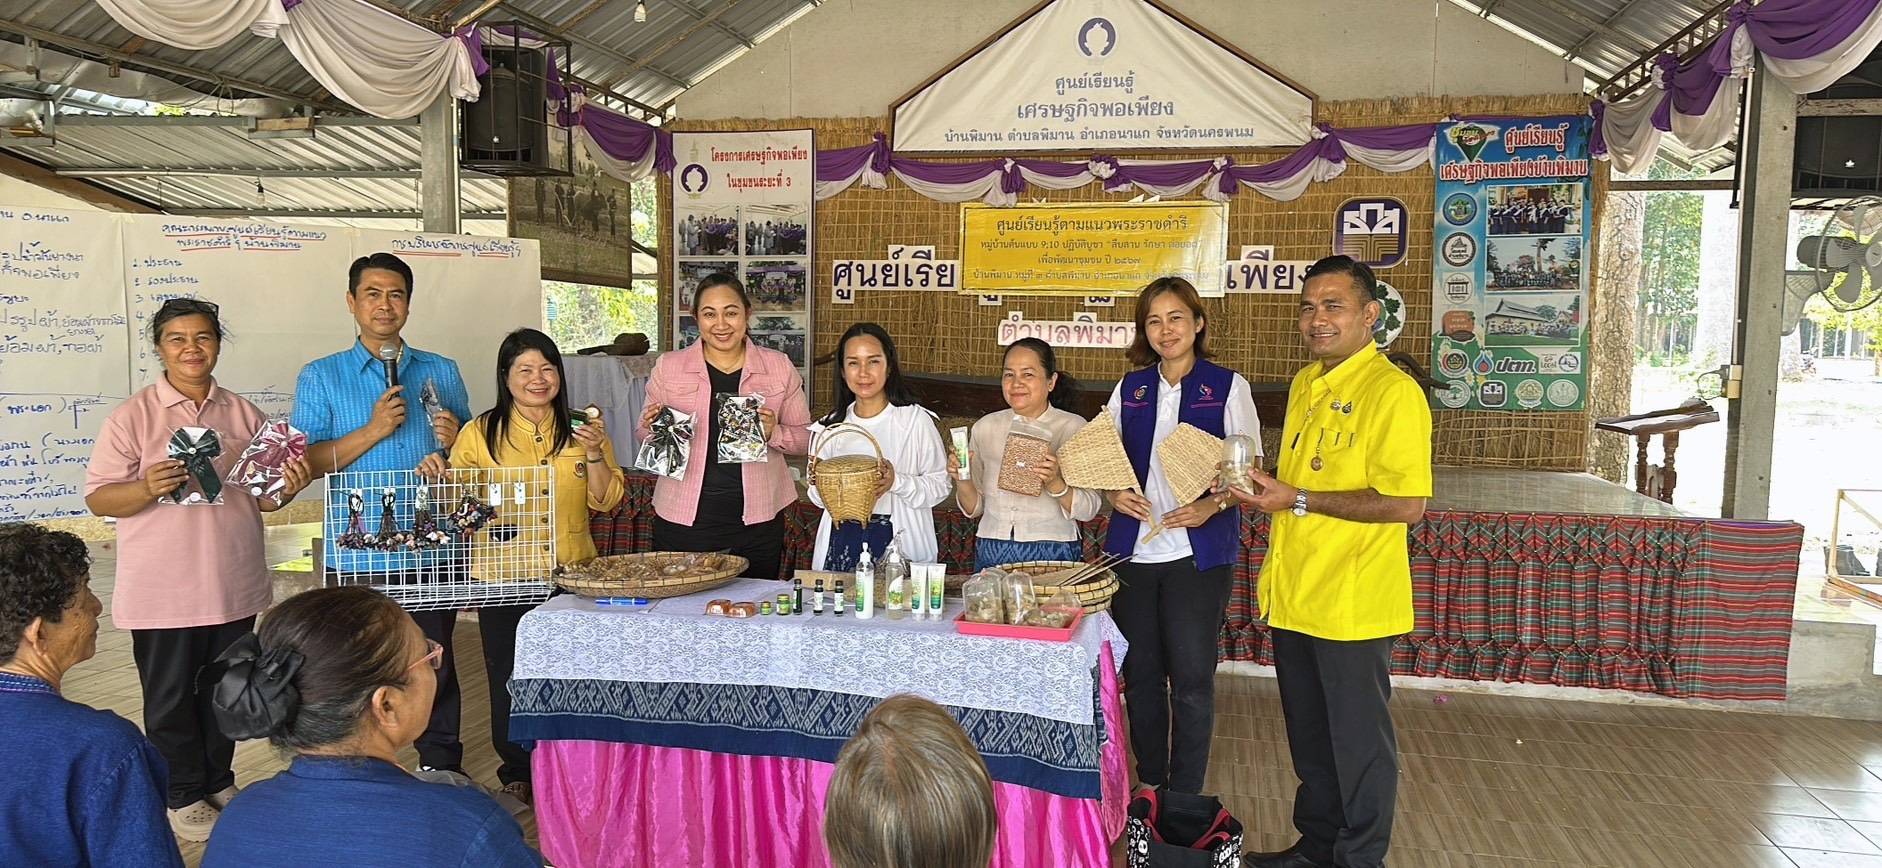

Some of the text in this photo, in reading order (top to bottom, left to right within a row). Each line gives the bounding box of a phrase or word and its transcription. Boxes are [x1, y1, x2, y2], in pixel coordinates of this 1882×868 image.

[1055, 70, 1135, 95] ศูนย์เรียนรู้
[1017, 96, 1174, 122] เศรษฐกิจพอเพียง
[945, 126, 1254, 142] บ้านพิมาน ตำบลพิมาน อำเภอนาแก จังหวัดนครพนม
[1505, 123, 1569, 152] ศูนย์เรียนรู้
[711, 145, 808, 164] โครงการเศรษฐกิจพอเพียง
[727, 170, 793, 192] ในชุมชนระยะที่ 3
[997, 214, 1188, 236] ศูนย์เรียนรู้ตามแนวพระราชดำริ
[834, 247, 955, 300] ศูนย์เรีย
[1002, 314, 1136, 345] ตำบลพิมา
